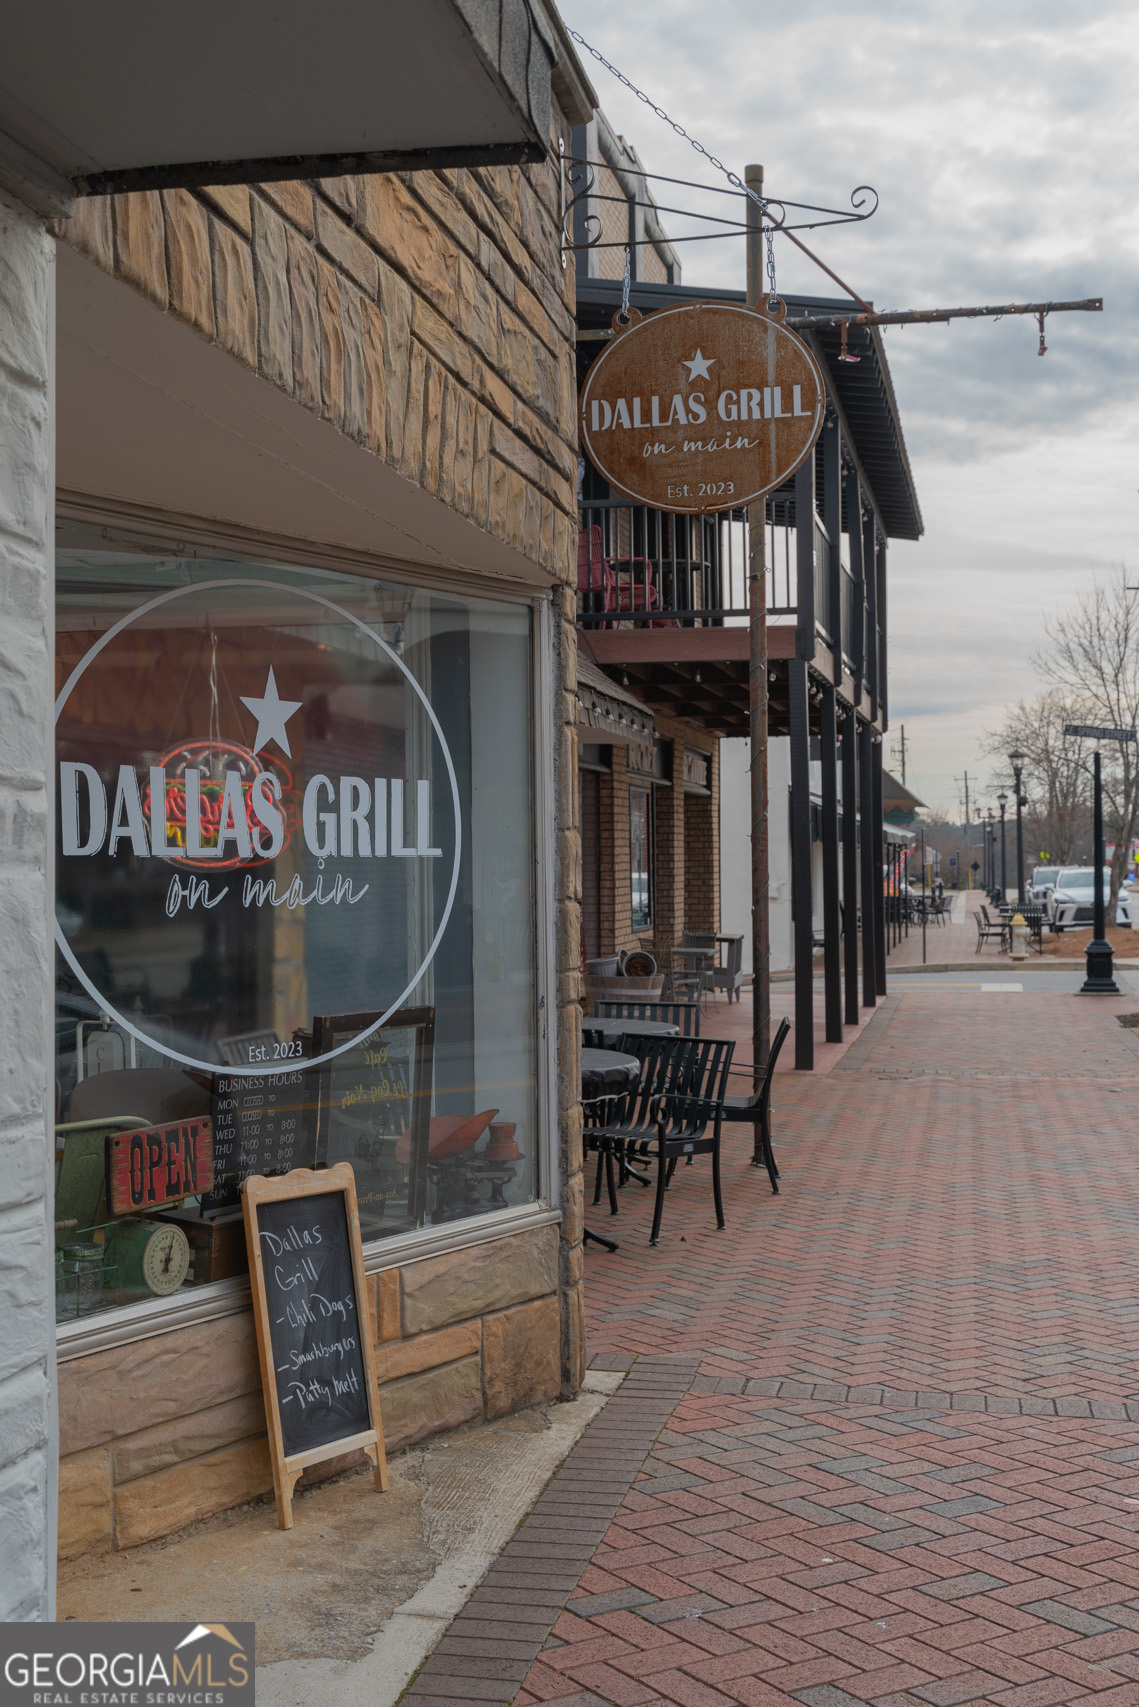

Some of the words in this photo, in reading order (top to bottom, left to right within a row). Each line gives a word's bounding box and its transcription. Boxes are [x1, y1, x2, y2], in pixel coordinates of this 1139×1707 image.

[590, 393, 707, 432] DALLAS
[717, 384, 812, 422] GRILL
[642, 441, 676, 458] on
[683, 431, 760, 452] main
[667, 484, 693, 498] Est.
[698, 481, 735, 496] 2023
[1105, 731, 1131, 740] STREET
[59, 760, 284, 858] DALLAS
[302, 773, 443, 858] GRILL
[165, 873, 229, 917] on
[241, 856, 369, 909] main
[248, 1045, 270, 1062] Est.
[273, 1041, 303, 1060] 2023
[218, 1076, 265, 1093] BUSINESS
[268, 1070, 303, 1087] HOURS
[217, 1098, 239, 1111] MON
[243, 1095, 264, 1107] CLOSED
[268, 1094, 276, 1102] TO
[217, 1113, 233, 1126] TUE
[241, 1110, 262, 1122] CLOSED
[267, 1109, 275, 1117] TO
[216, 1128, 236, 1140] WED
[266, 1123, 274, 1131] TO
[281, 1119, 296, 1130] 8:00
[215, 1143, 233, 1156] THU
[240, 1140, 259, 1152] 11:00
[265, 1138, 272, 1146] TO
[280, 1133, 295, 1145] 8:00
[129, 1125, 199, 1206] OPEN
[214, 1159, 226, 1170] FRI
[240, 1154, 257, 1166] 11:00
[278, 1148, 293, 1159] 8:00
[276, 1162, 291, 1174] 8:00
[210, 1188, 228, 1201] SUN
[259, 1225, 322, 1256] Dallas
[275, 1257, 319, 1291] Grill
[310, 1293, 353, 1322] Dogs
